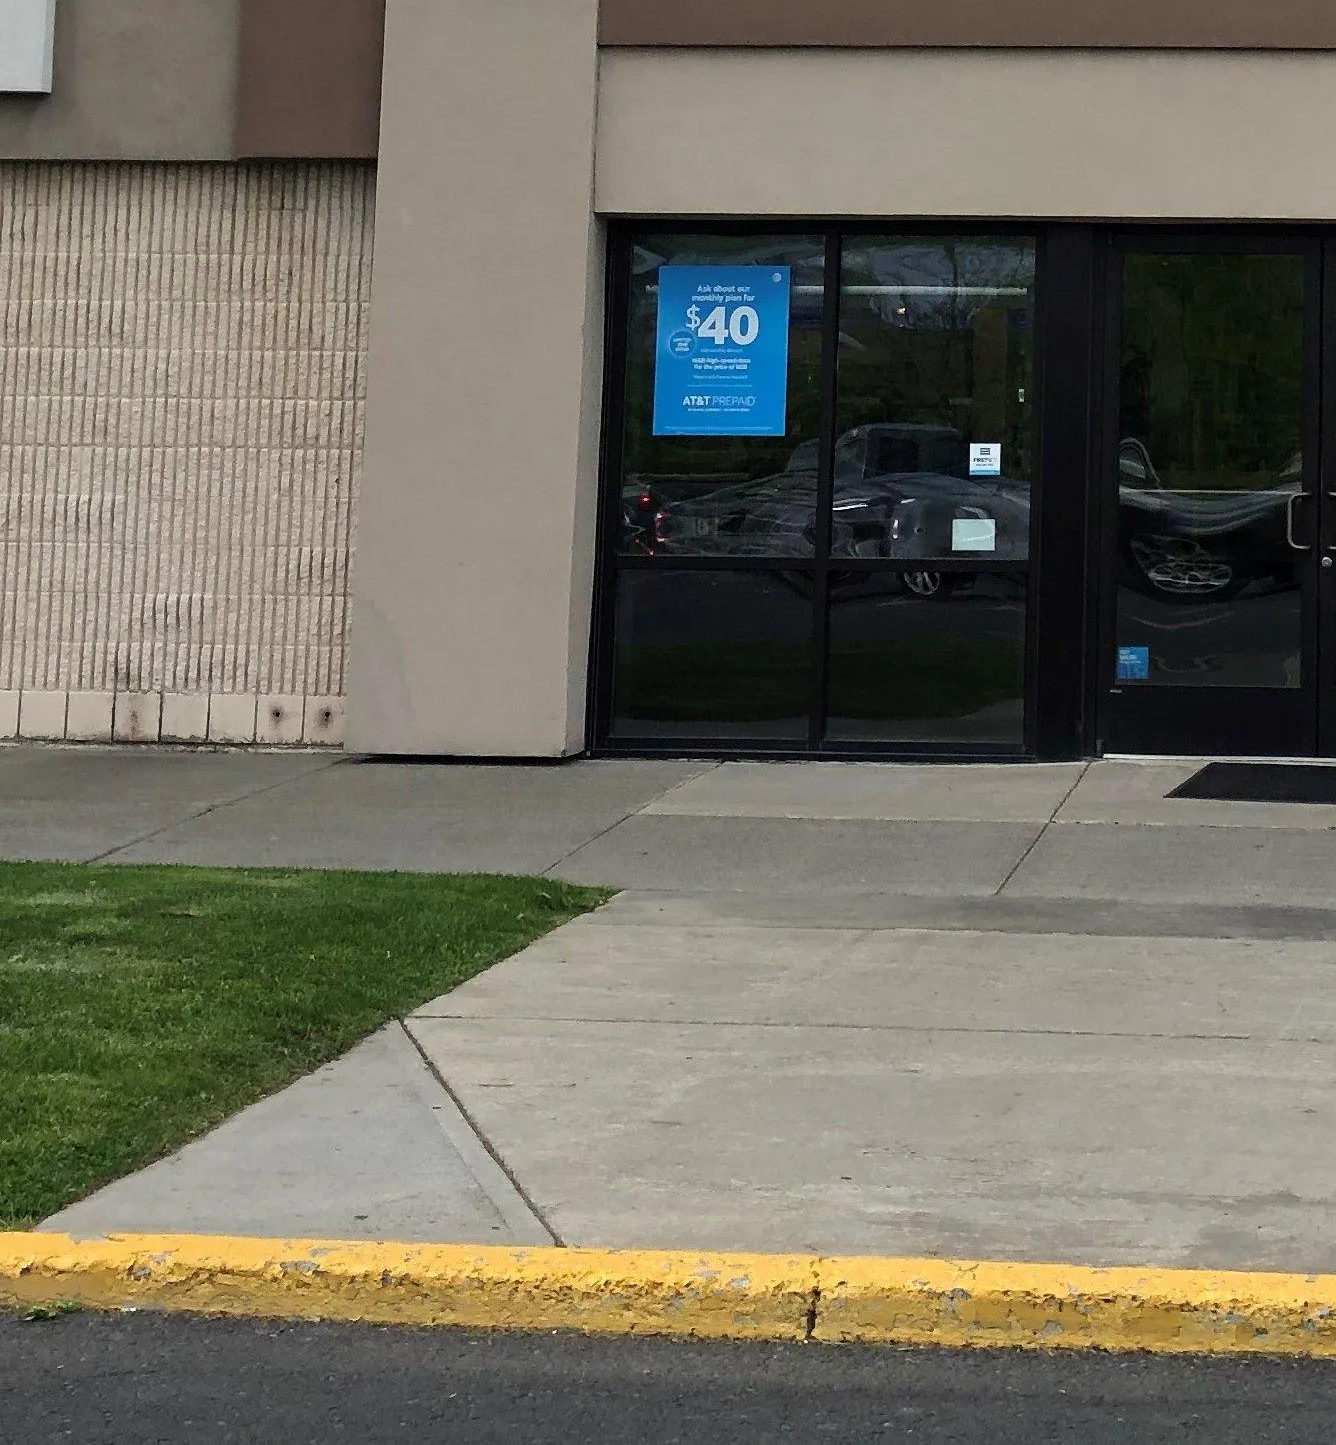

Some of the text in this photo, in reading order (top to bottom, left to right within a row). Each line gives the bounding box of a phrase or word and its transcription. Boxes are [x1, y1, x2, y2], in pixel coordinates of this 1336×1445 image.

[713, 285, 735, 293] about
[692, 294, 724, 303] monthly
[685, 304, 759, 345] $40
[682, 395, 756, 406] AT&T PREPAID
